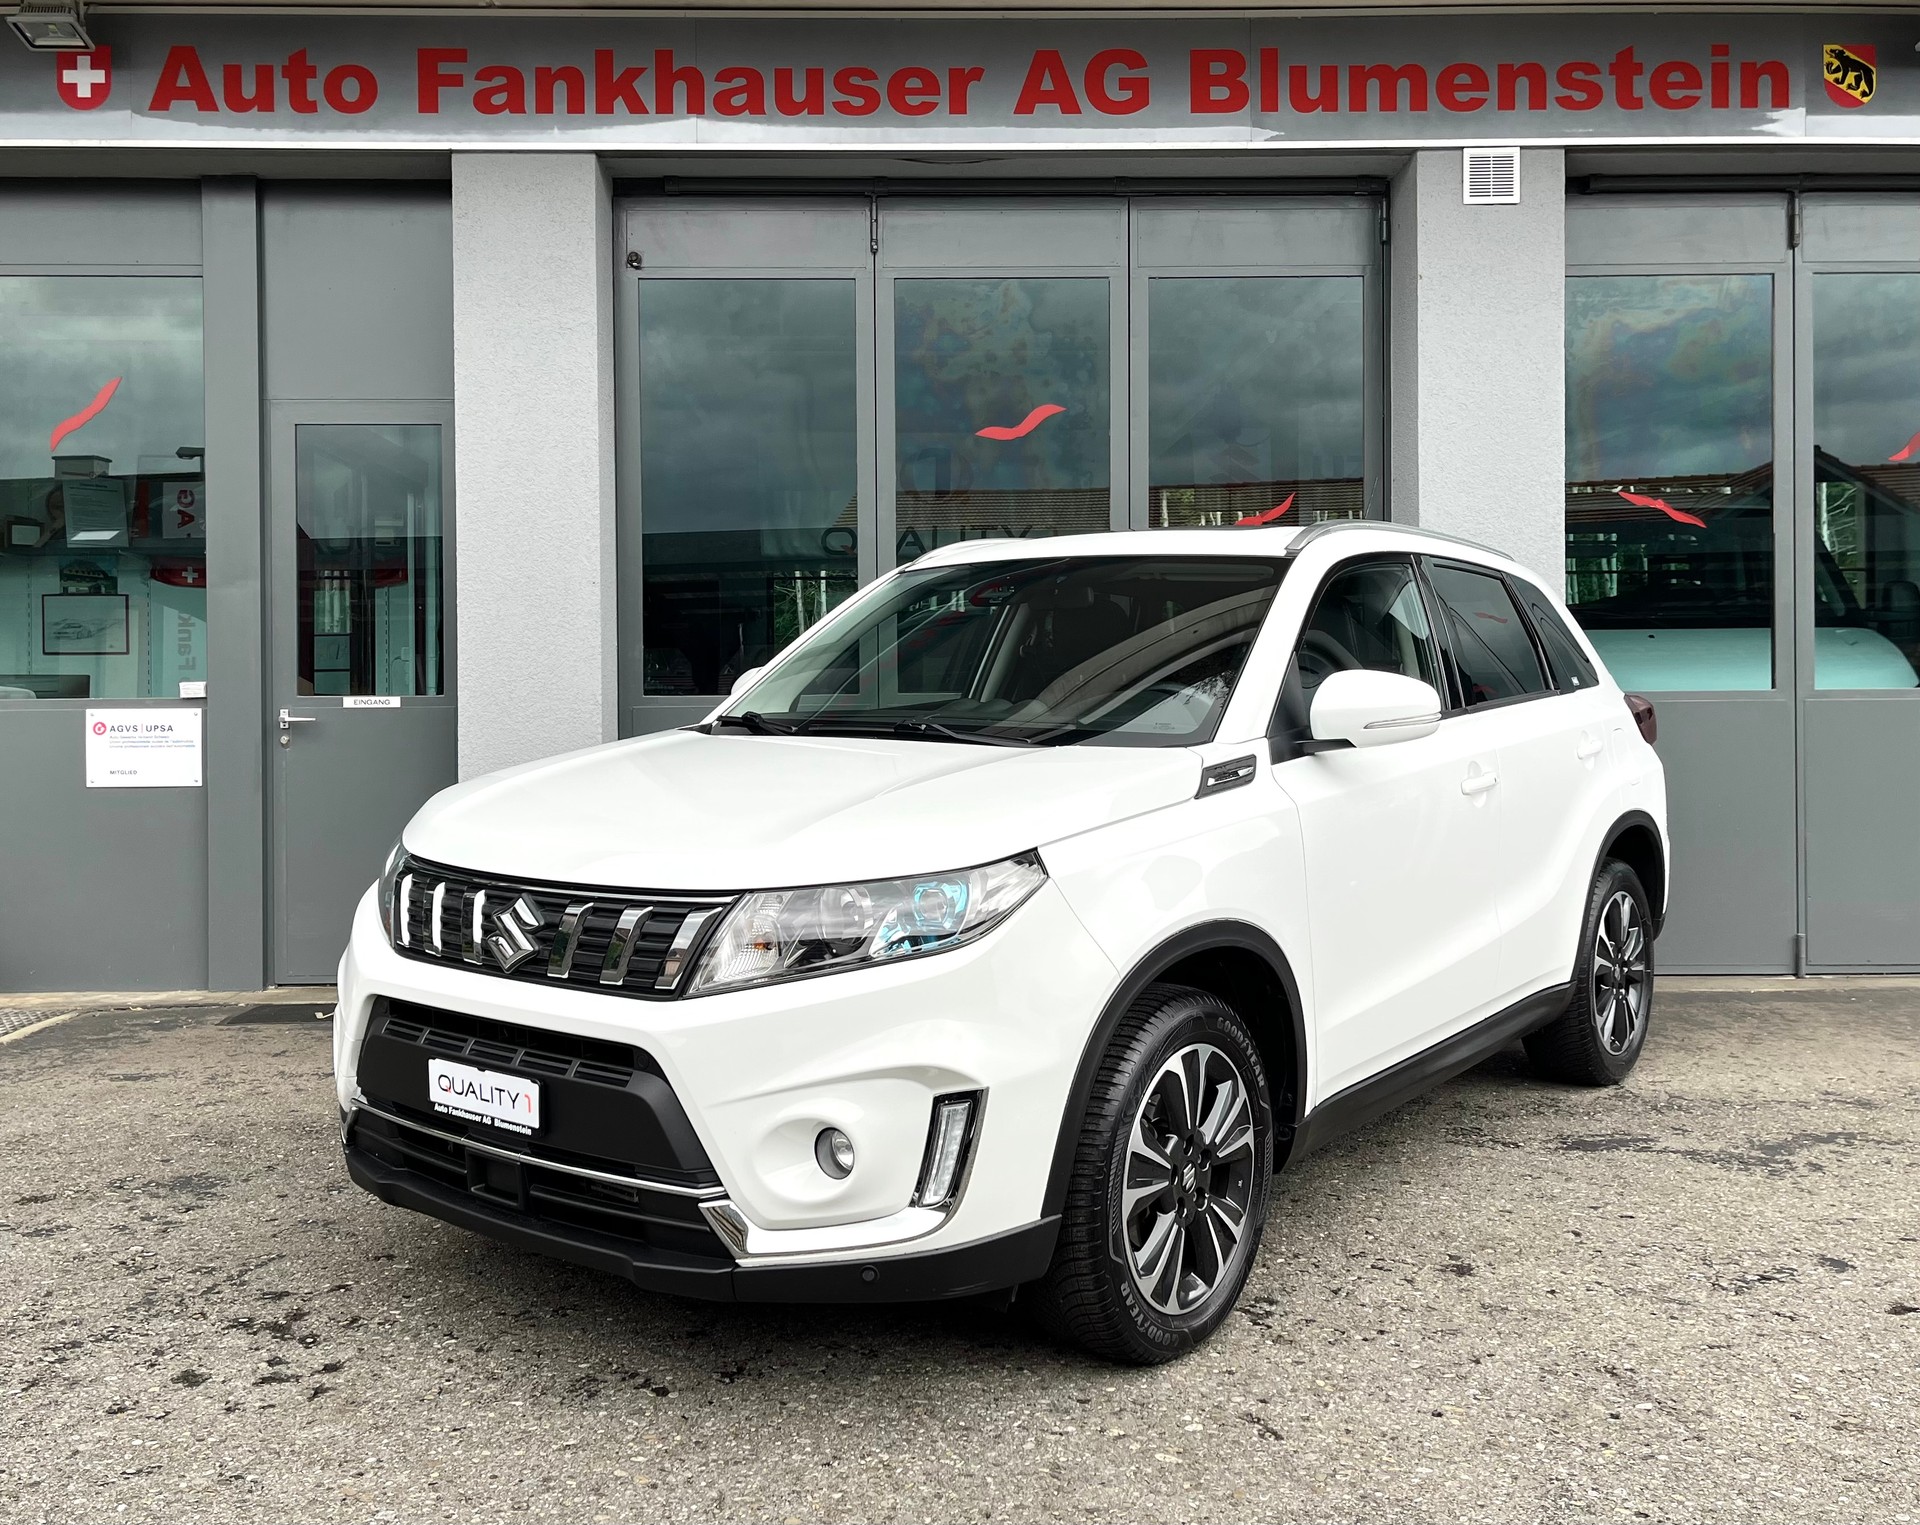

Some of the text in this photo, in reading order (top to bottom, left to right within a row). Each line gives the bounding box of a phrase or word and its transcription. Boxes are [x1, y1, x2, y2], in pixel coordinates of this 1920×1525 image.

[149, 44, 1790, 116] Auto Fankhauser AG Blumenstein
[353, 698, 391, 706] EINGANG
[109, 724, 174, 733] AGVS UPSA
[438, 1074, 531, 1113] QUALITY 1
[434, 1103, 532, 1136] Auto Fankhauser AG Blumenstein
